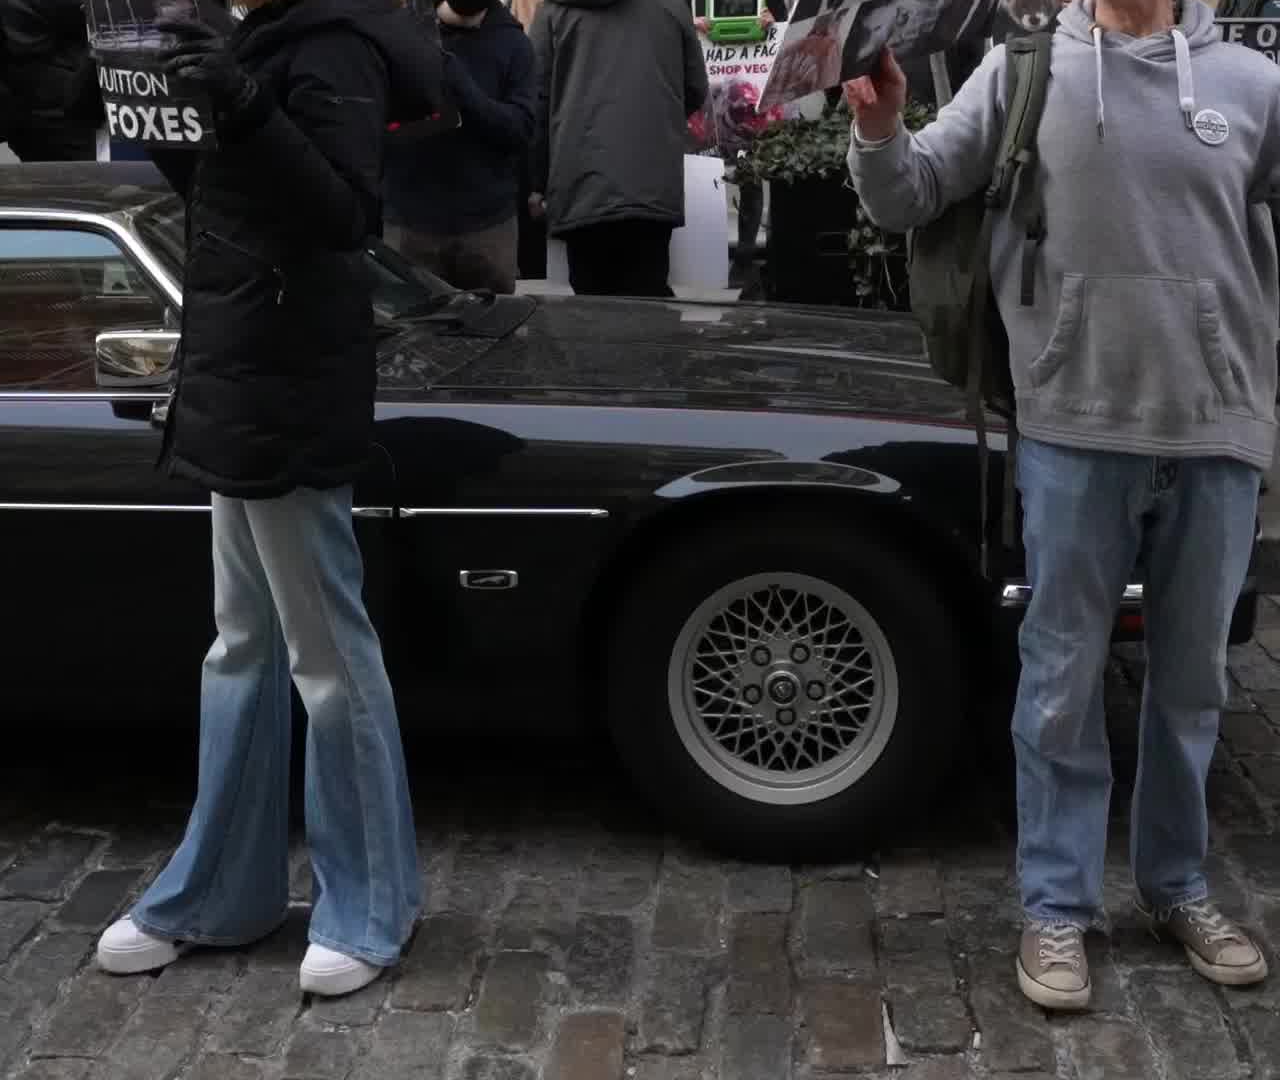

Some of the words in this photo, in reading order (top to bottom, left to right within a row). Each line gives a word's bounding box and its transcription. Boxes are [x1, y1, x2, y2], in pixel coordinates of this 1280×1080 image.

[706, 47, 737, 62] HAD
[739, 46, 749, 61] A
[753, 44, 777, 59] FAC
[709, 64, 742, 76] SHOP
[744, 63, 769, 75] VEG
[105, 102, 203, 143] FOXES
